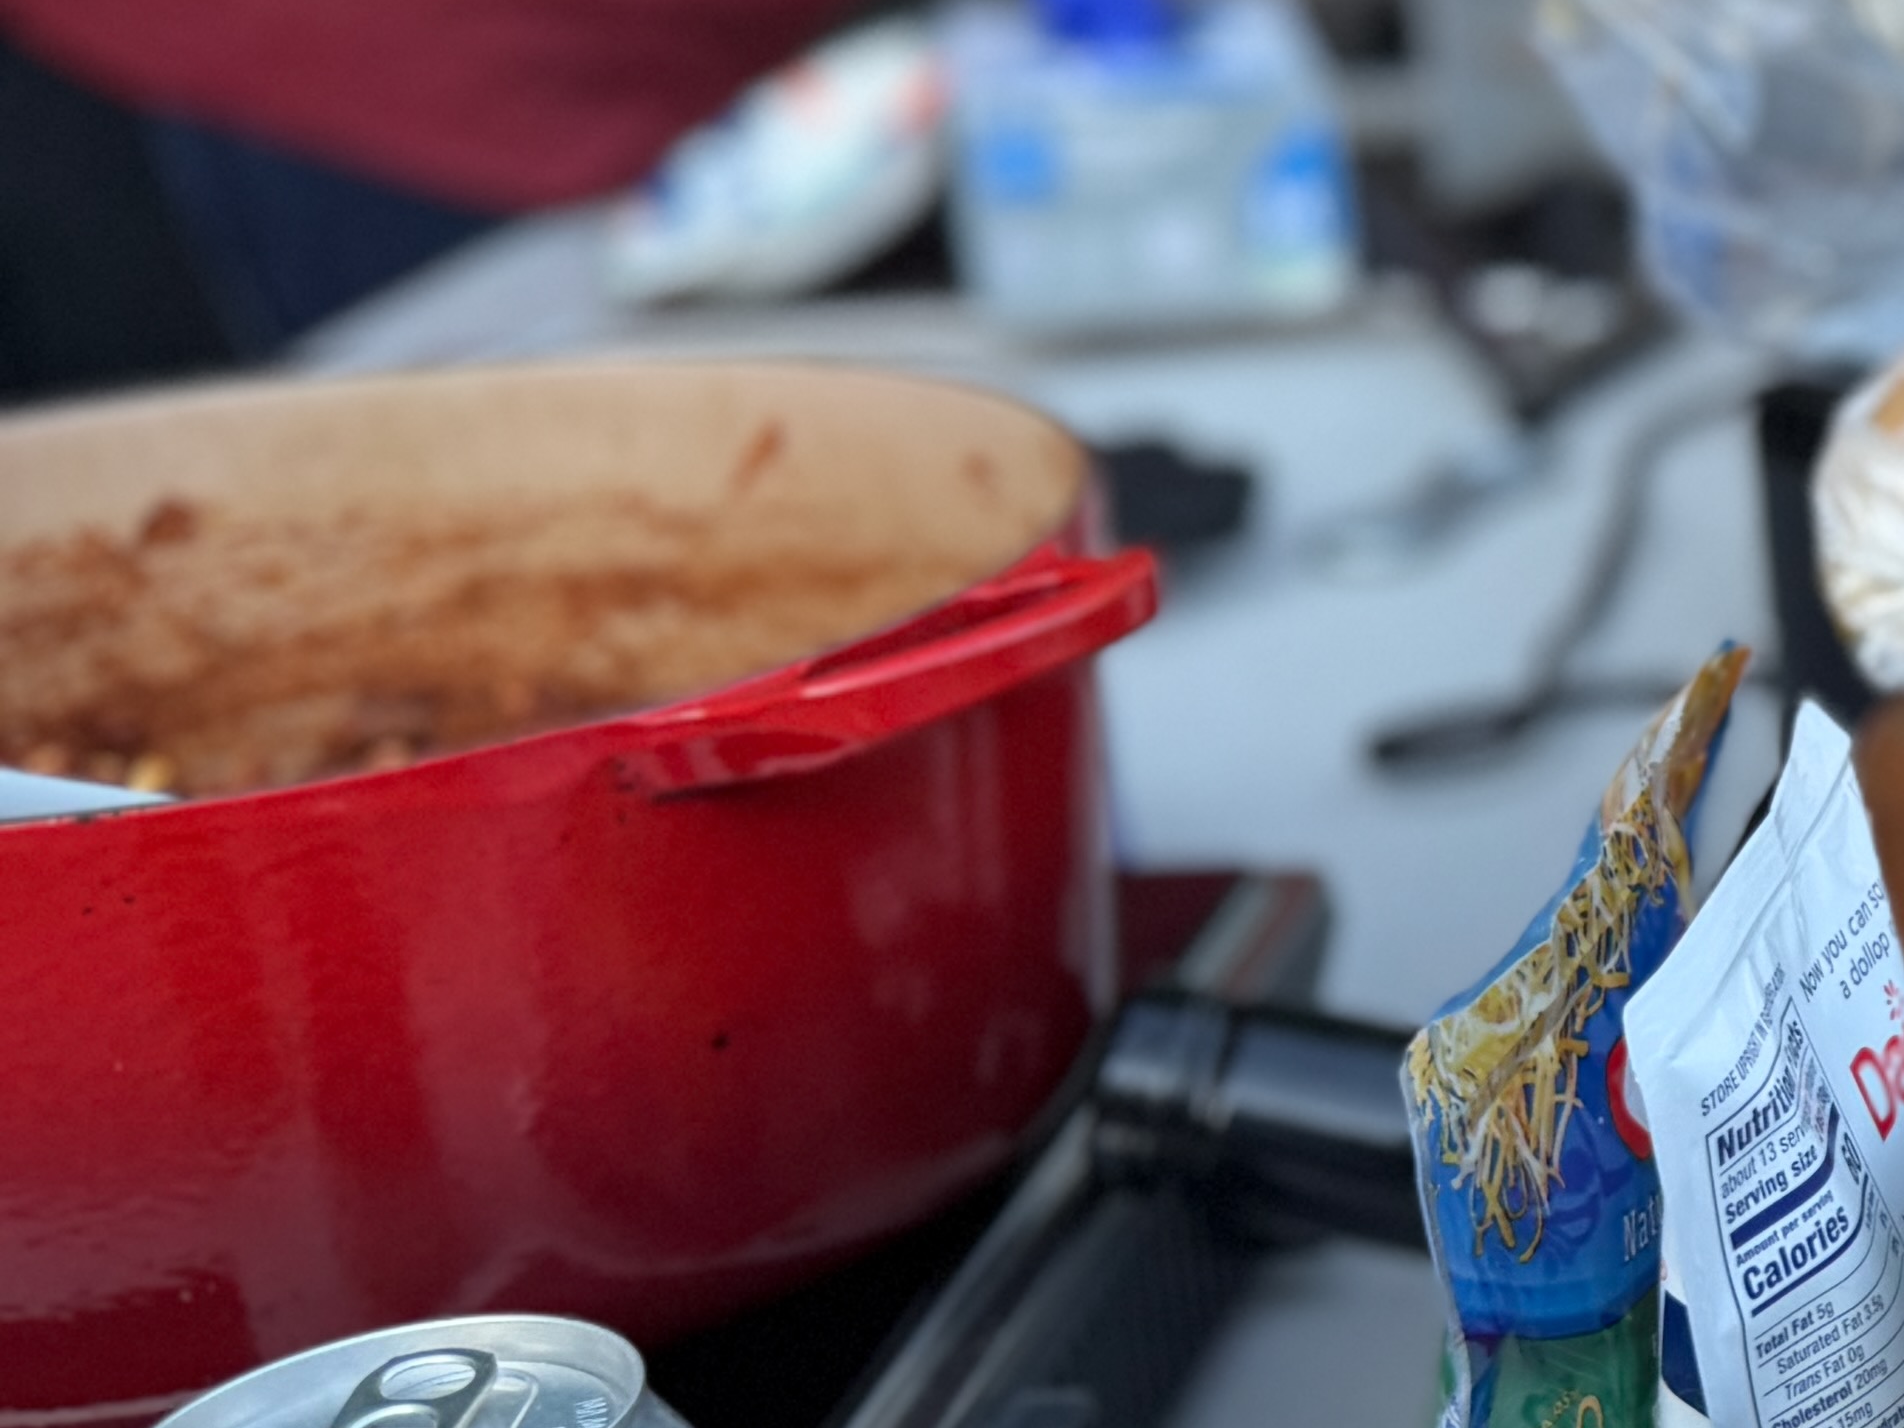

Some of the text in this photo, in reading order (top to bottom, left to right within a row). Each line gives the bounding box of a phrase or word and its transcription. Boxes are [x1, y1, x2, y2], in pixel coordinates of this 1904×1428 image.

[1799, 900, 1873, 1003] Now you can
[1840, 980, 1851, 1000] a
[1849, 931, 1891, 987] dollop
[1700, 1069, 1741, 1117] STORE
[1720, 1141, 1776, 1199] about 13
[1724, 1145, 1819, 1225] Serving size
[1735, 1189, 1834, 1267] Amount per serving
[1742, 1205, 1849, 1301] Calories
[1755, 1301, 1835, 1359] Total Fat 5g
[1777, 1315, 1862, 1374] Saturated Fat
[1784, 1344, 1865, 1401] Trans Fat 0g
[1855, 1358, 1888, 1390] 20mg
